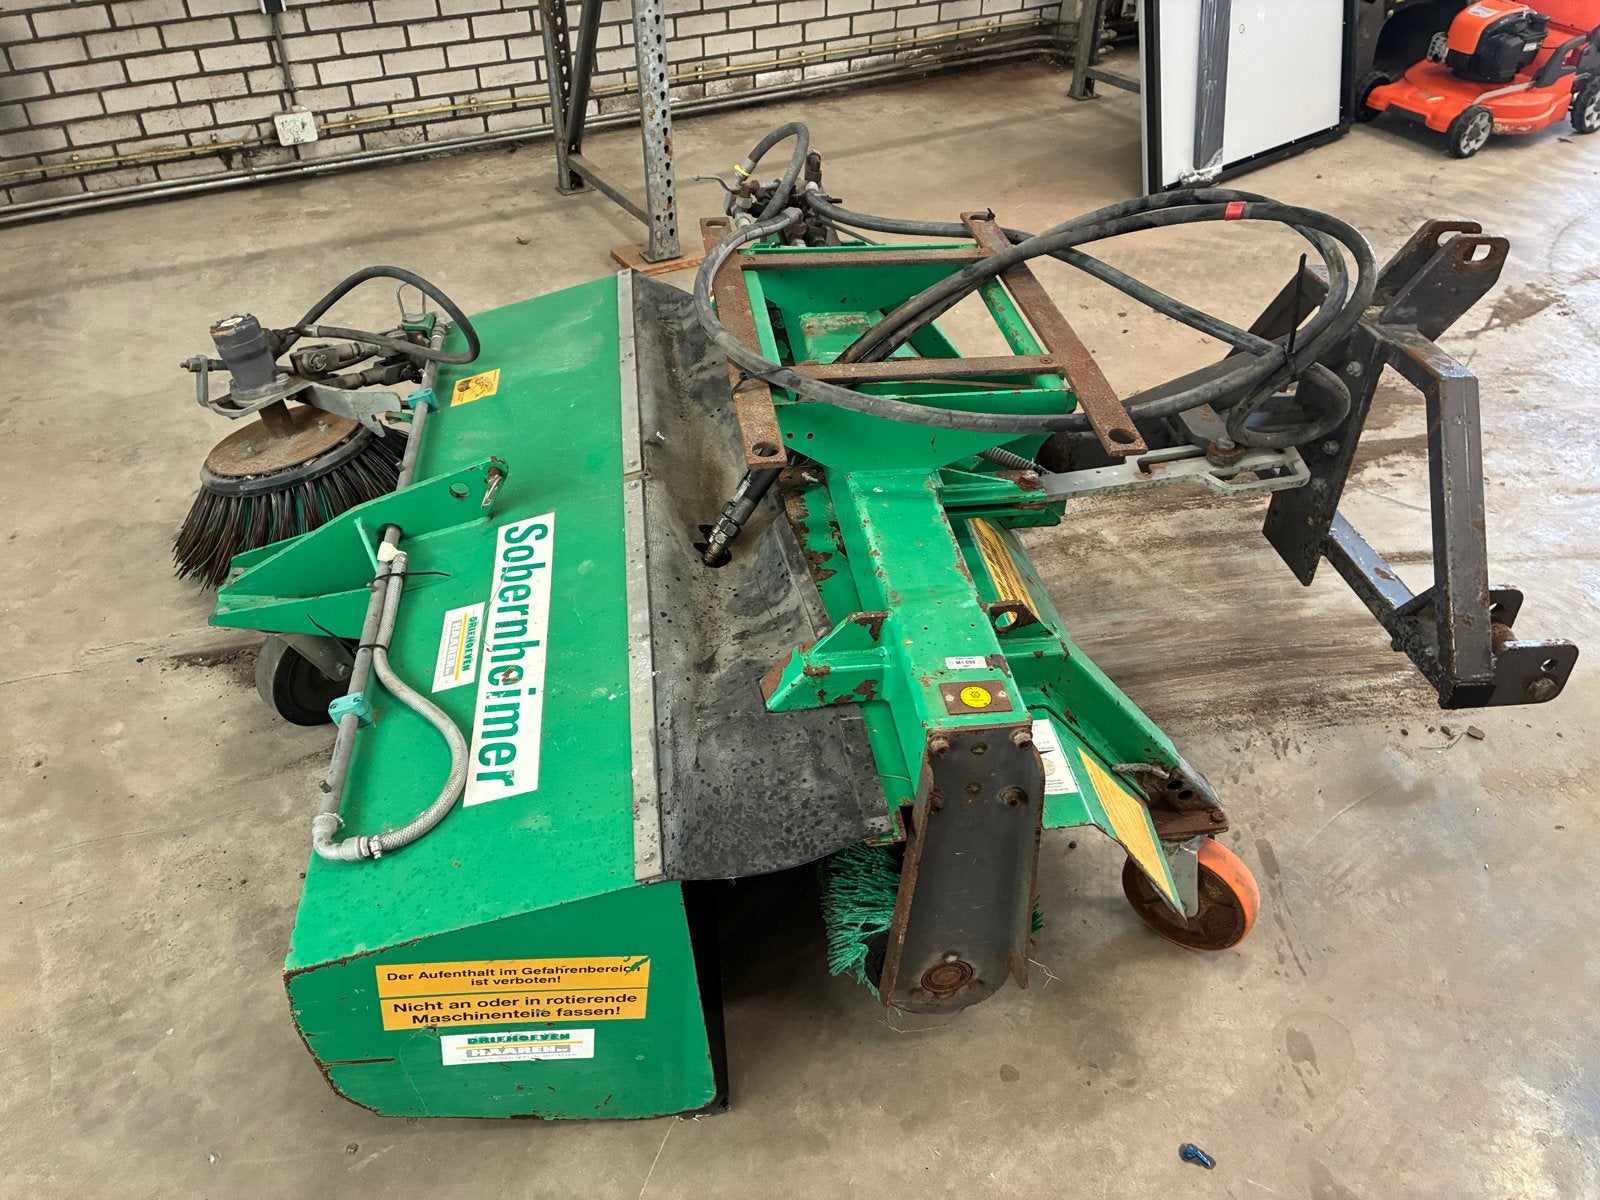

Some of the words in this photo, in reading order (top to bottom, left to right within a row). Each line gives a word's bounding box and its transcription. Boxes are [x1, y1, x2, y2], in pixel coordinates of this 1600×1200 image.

[475, 522, 549, 787] Sobernheimer
[387, 972, 414, 981] Der
[418, 968, 495, 980] Aufenthalt
[499, 968, 517, 976] im
[471, 978, 488, 986] ist
[493, 975, 561, 985] verboten!
[393, 1001, 443, 1013] Nicht
[448, 999, 472, 1009] an
[477, 996, 519, 1008] oder
[524, 995, 541, 1006] in
[546, 993, 637, 1005] rotierende
[412, 1008, 551, 1024] Maschinenteile
[556, 1006, 621, 1017] fassen!
[467, 1033, 570, 1045] DRIEHOEVEN
[471, 1046, 556, 1057] HAAREN
